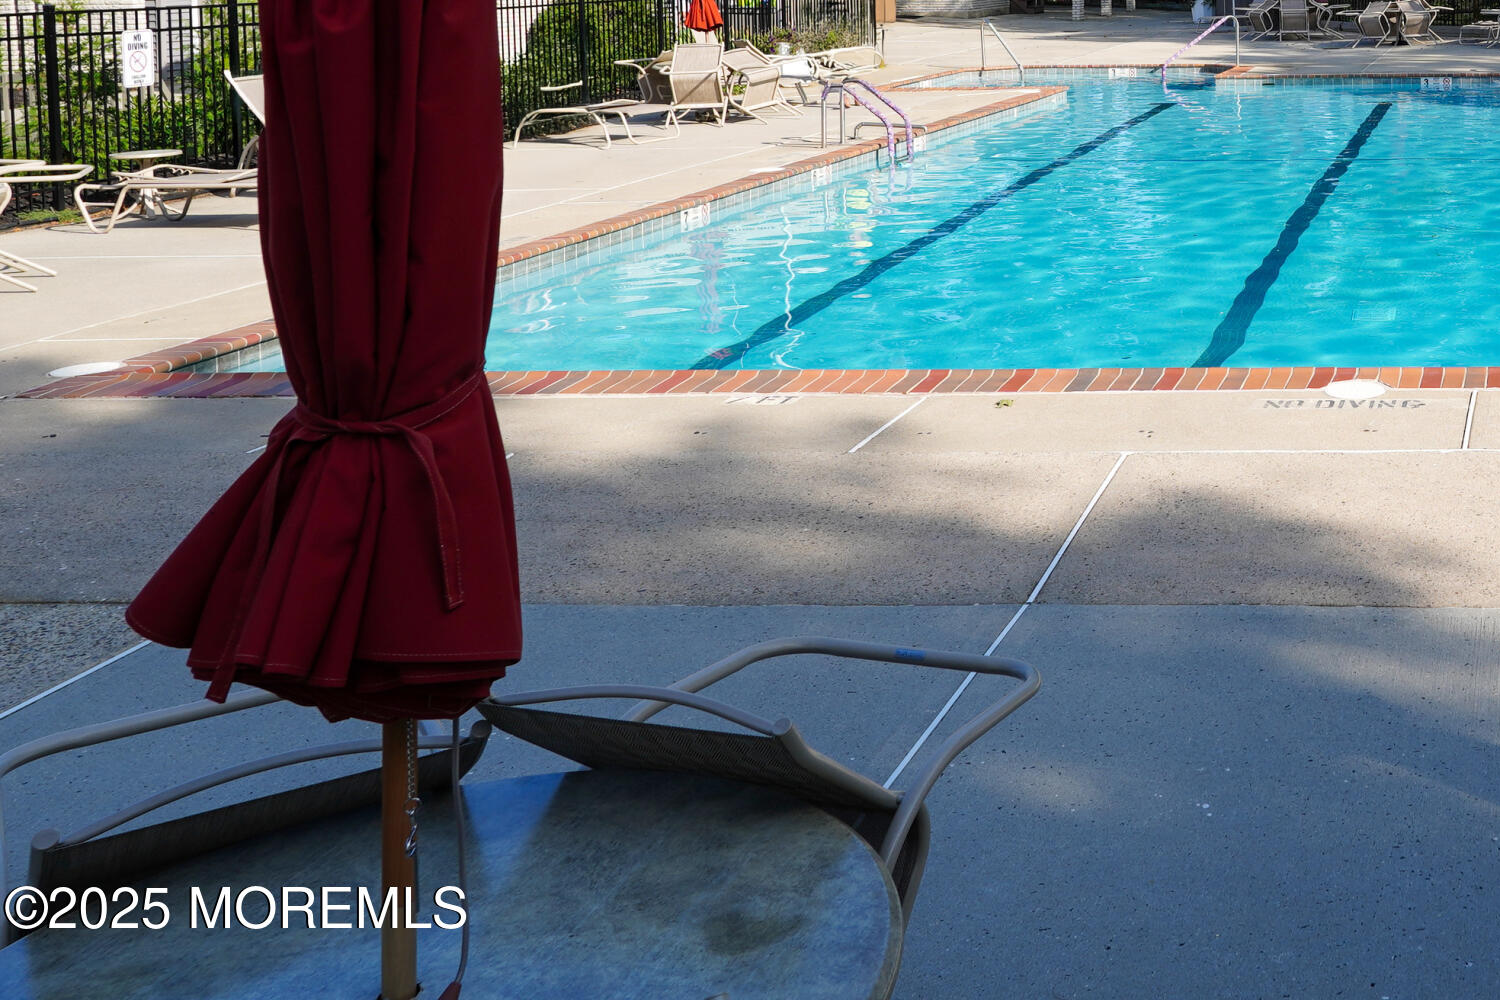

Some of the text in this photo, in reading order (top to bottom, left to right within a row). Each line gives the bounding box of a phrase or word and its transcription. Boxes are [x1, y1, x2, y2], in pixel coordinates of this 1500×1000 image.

[133, 33, 142, 41] NO
[127, 41, 149, 51] DIVING
[755, 395, 800, 404] FT
[1262, 399, 1427, 409] NO DIVING
